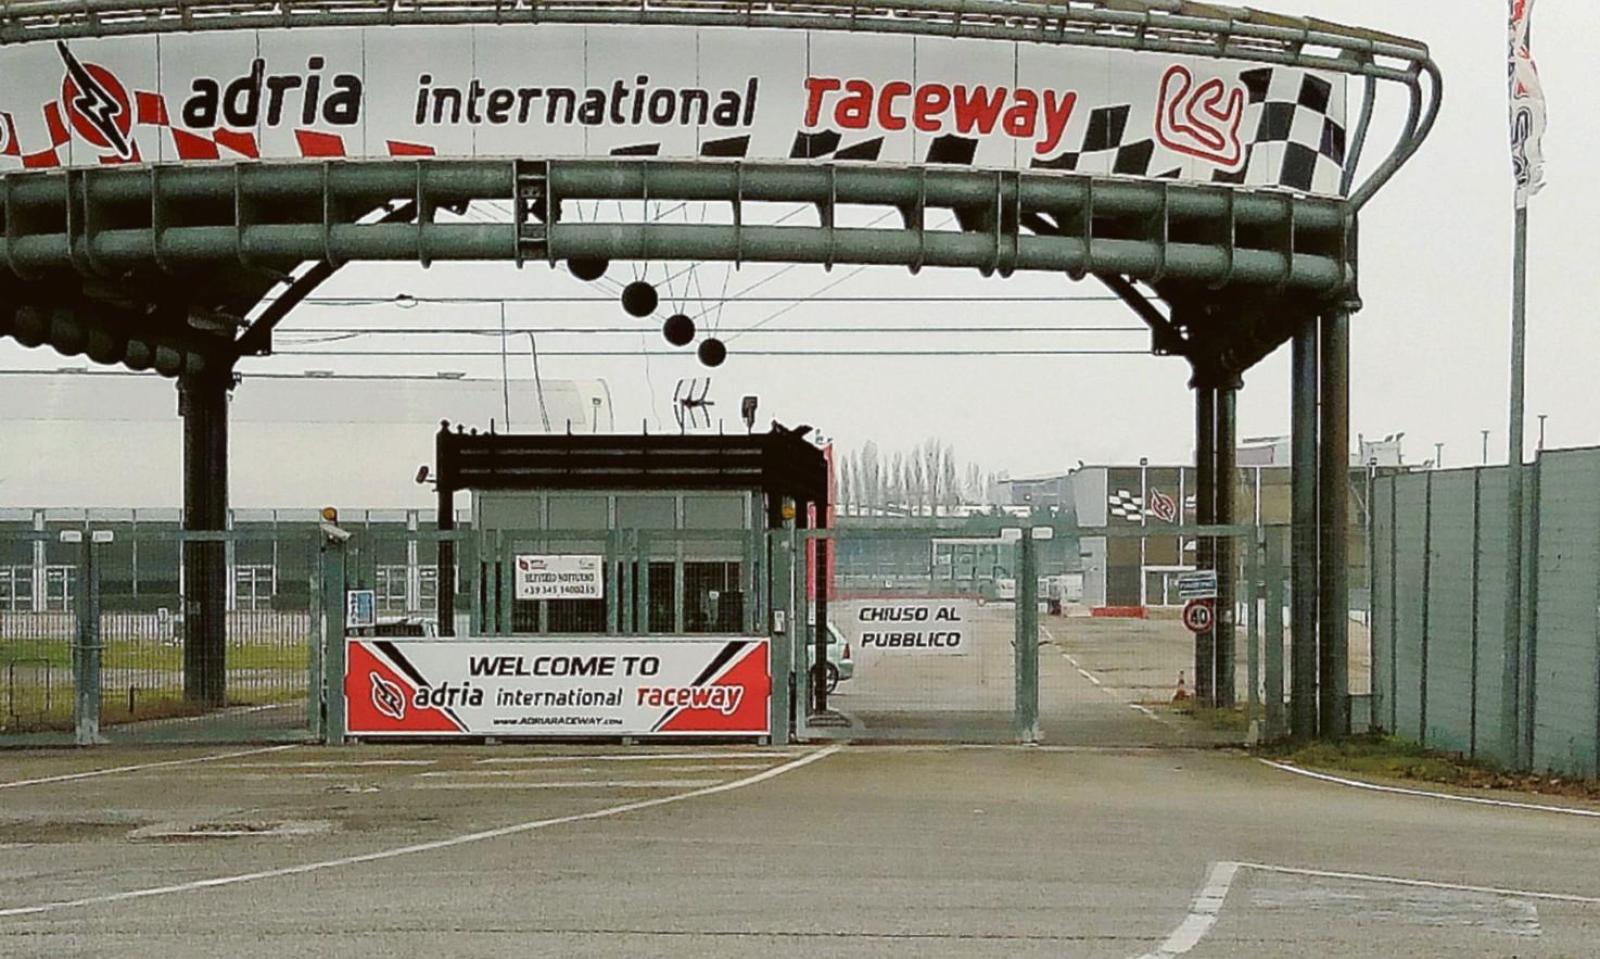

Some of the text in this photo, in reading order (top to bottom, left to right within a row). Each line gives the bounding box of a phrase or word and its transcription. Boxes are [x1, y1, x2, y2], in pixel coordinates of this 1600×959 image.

[182, 56, 1077, 153] adria international raceway
[859, 607, 961, 621] CHIUSO AL
[1191, 608, 1208, 625] 40
[861, 632, 961, 648] PUBBLICO
[469, 656, 660, 676] WELCOME TO
[414, 681, 744, 714] adria international raceway
